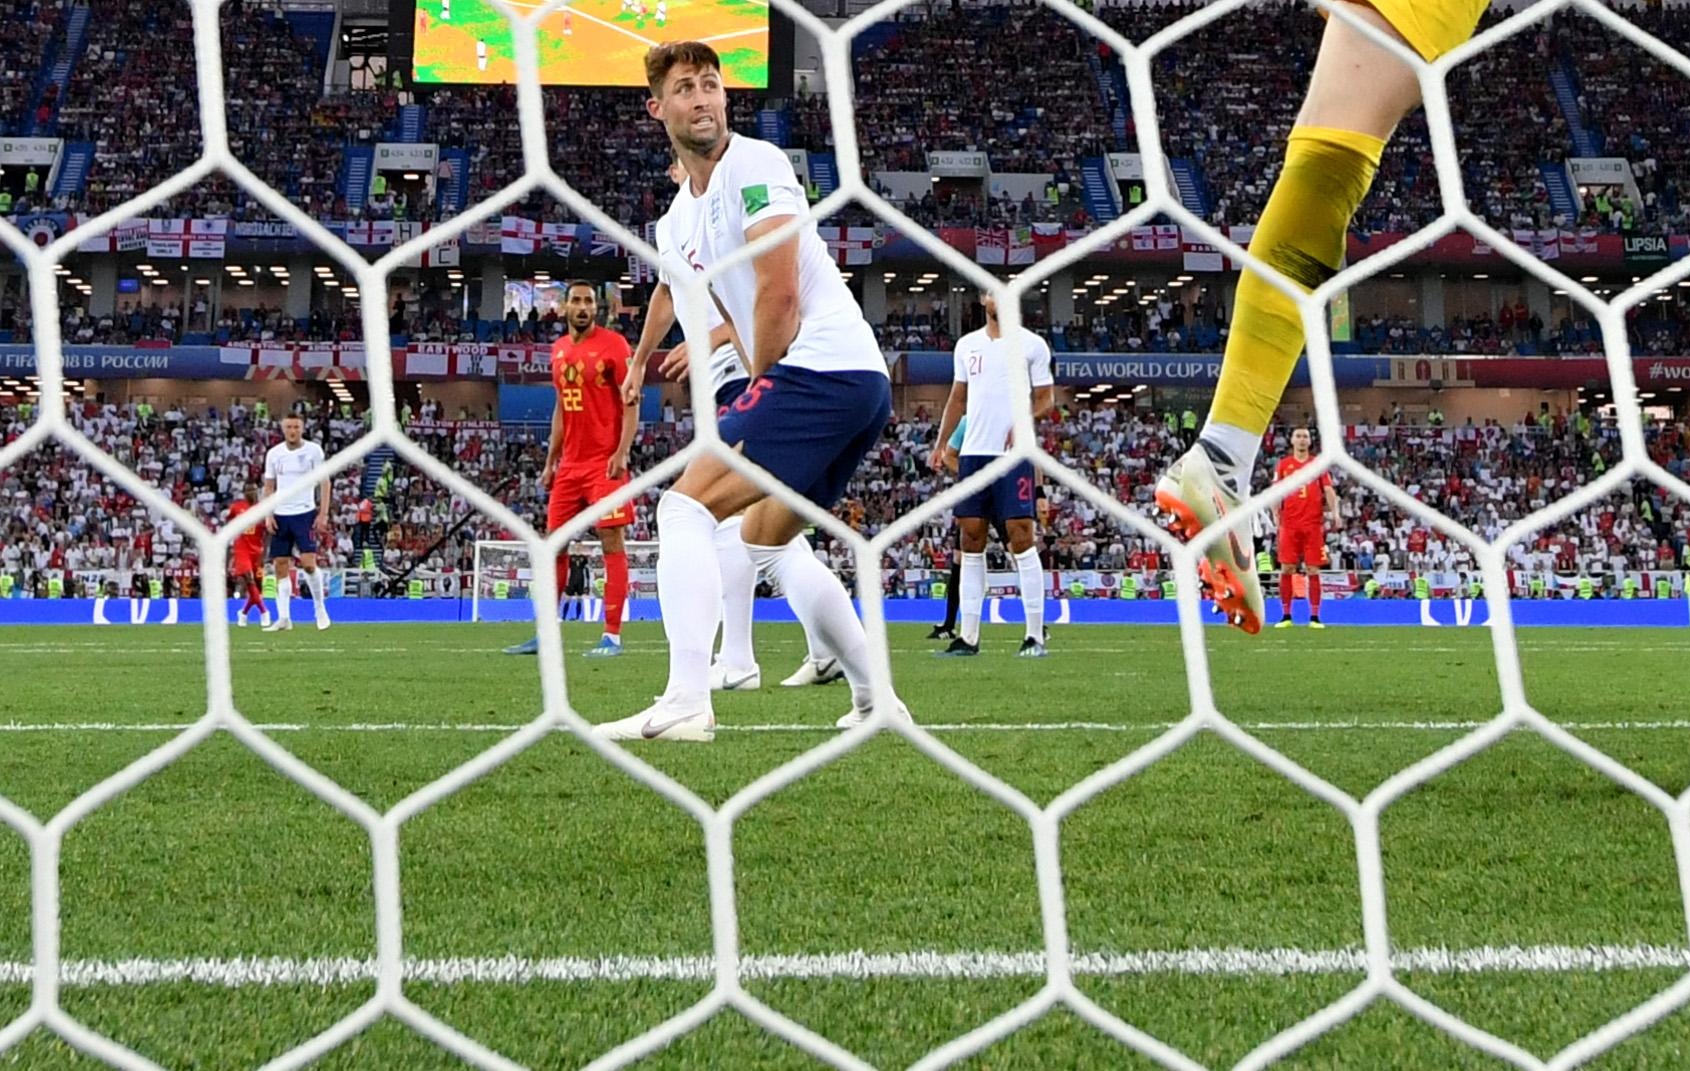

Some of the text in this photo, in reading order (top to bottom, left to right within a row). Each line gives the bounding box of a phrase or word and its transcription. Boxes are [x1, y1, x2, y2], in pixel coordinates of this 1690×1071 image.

[1624, 237, 1667, 252] LIPSIA
[417, 344, 488, 355] EASTWOOD
[102, 355, 169, 369] РОССИИ
[968, 355, 982, 376] 21
[1056, 362, 1094, 378] FIFA
[1096, 362, 1161, 378] WORLD
[1166, 362, 1202, 379] CUP
[563, 388, 583, 411] 22
[1017, 478, 1032, 500] 21
